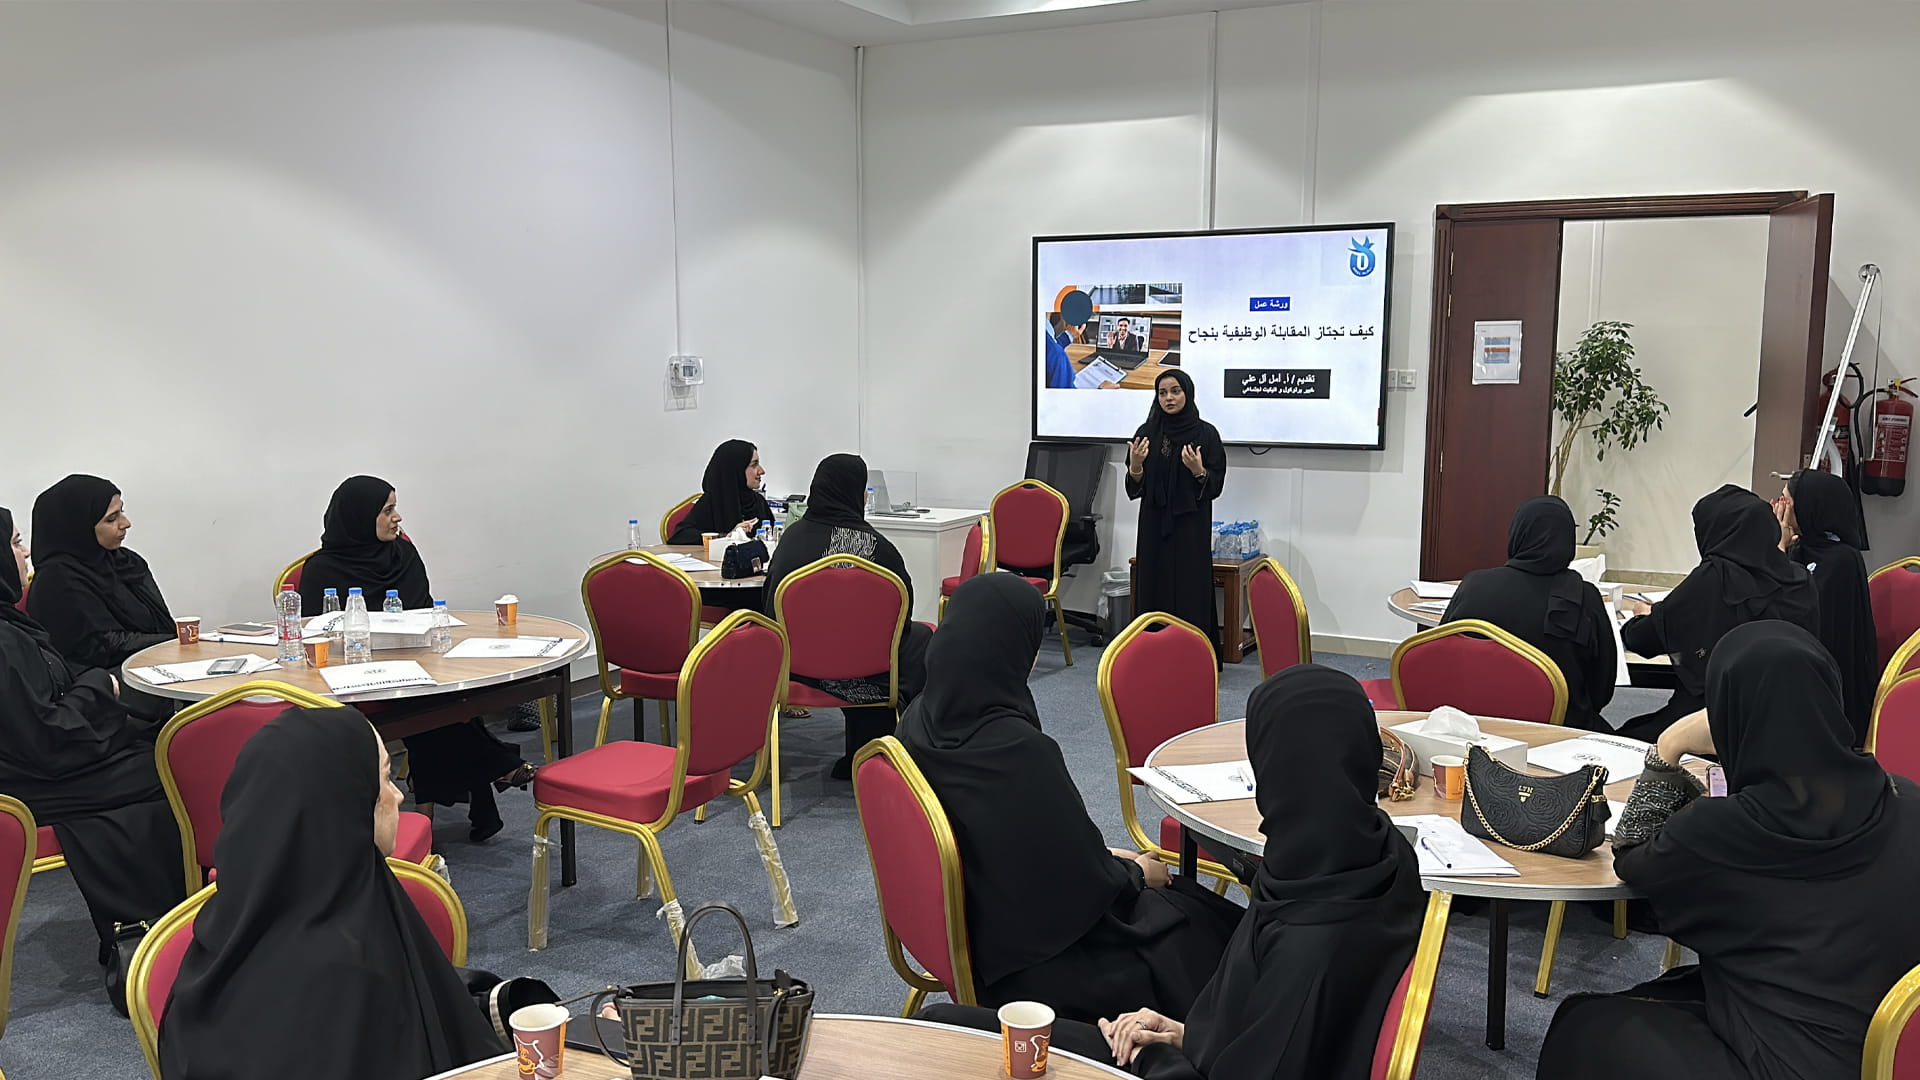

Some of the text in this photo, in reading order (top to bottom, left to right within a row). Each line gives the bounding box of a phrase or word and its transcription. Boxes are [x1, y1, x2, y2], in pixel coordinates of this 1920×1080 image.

[1254, 298, 1288, 309] ورشة عمل
[1188, 323, 1374, 343] كيف تجتاز المقابلة الوظيفية بنجاح
[1242, 374, 1256, 386] علي
[1296, 374, 1315, 386] تقديم
